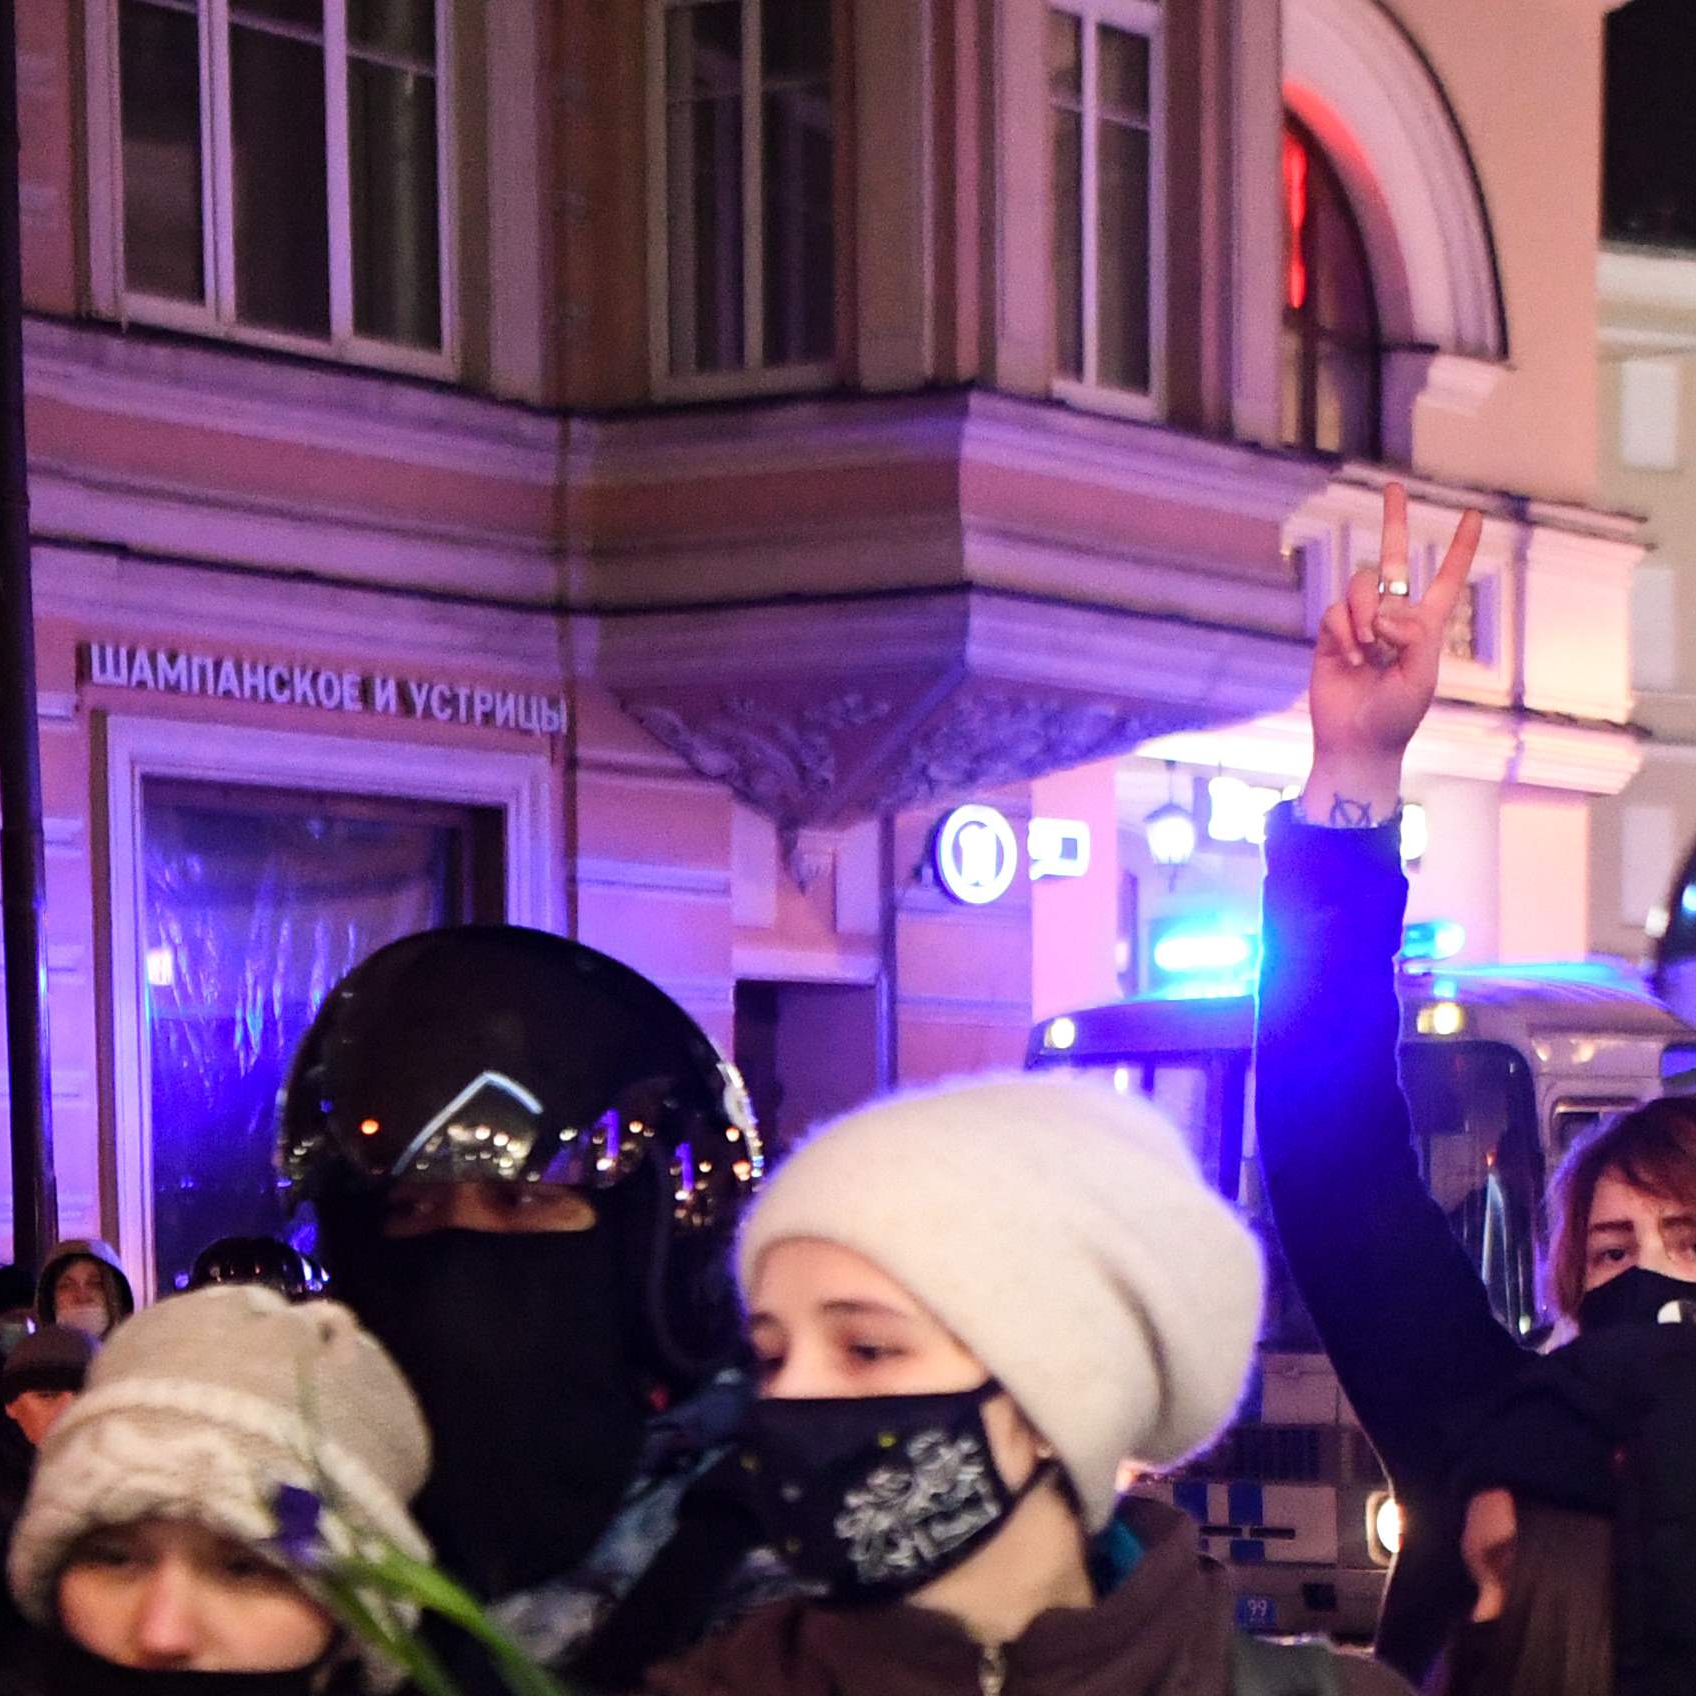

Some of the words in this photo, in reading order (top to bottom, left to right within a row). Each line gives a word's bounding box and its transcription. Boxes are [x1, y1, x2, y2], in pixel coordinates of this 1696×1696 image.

[90, 642, 362, 712] ШАМПАНСКОЕ
[374, 677, 397, 714] И
[409, 681, 569, 735] УСТРИЦЫ
[1247, 1599, 1268, 1618] 99
